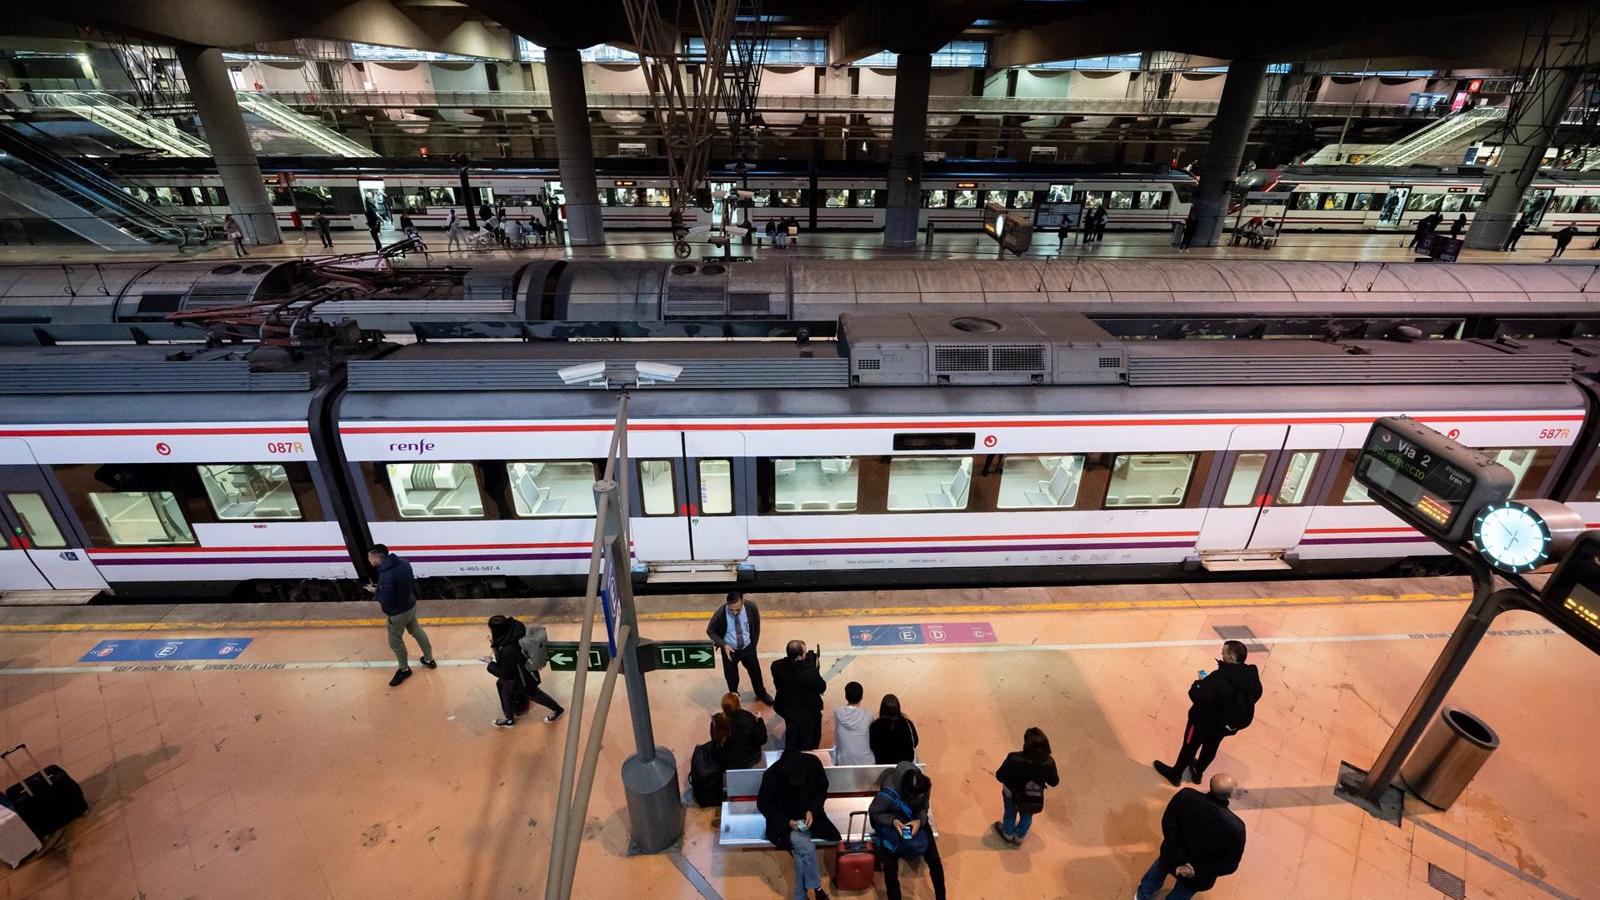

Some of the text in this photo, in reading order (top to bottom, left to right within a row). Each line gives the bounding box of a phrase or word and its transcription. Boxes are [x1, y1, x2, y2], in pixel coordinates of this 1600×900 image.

[1539, 428, 1570, 439] 587R
[267, 442, 304, 454] 087R
[389, 438, 435, 455] renfe
[1420, 454, 1432, 467] 2
